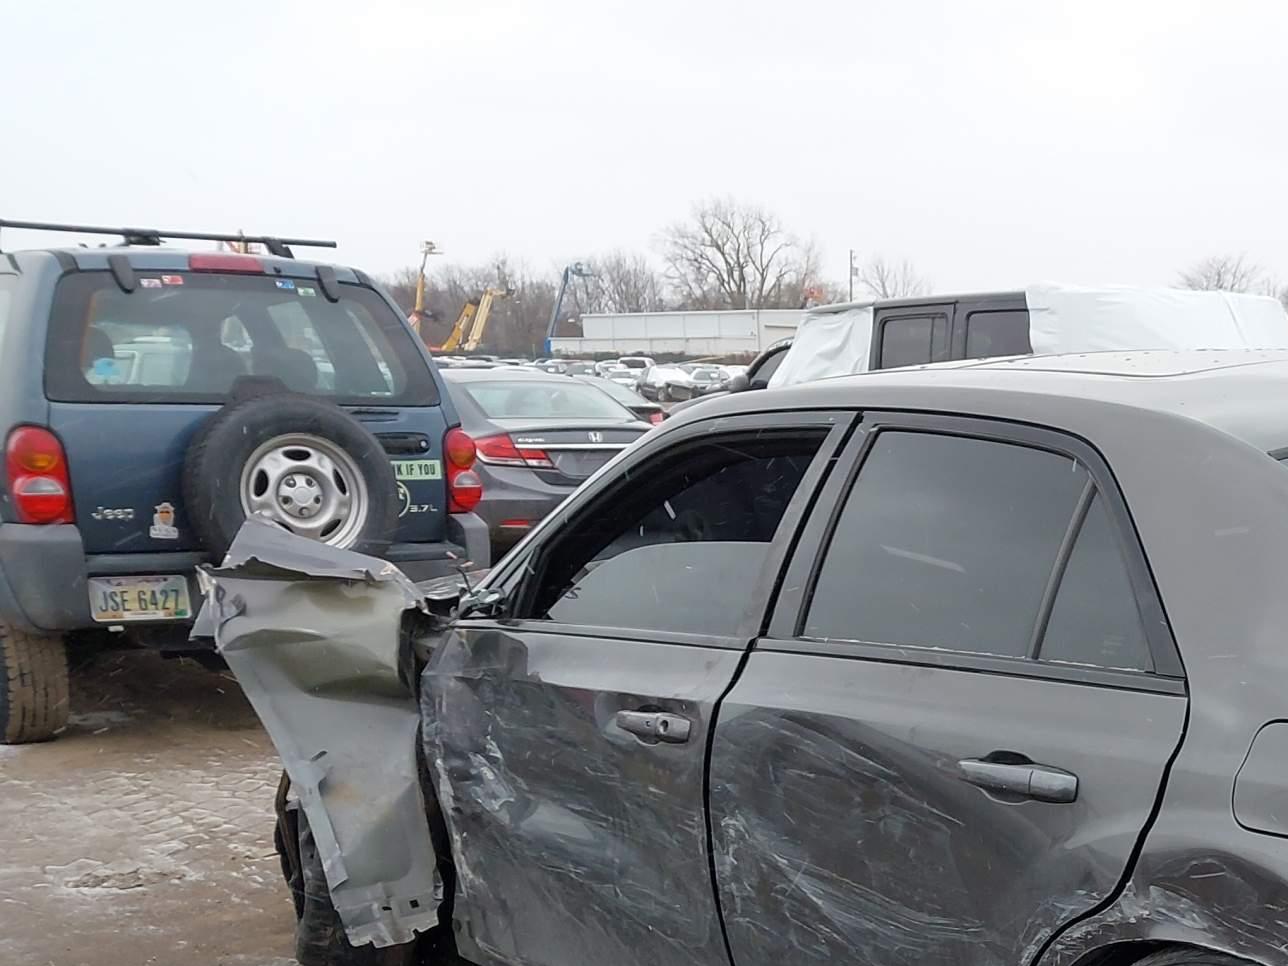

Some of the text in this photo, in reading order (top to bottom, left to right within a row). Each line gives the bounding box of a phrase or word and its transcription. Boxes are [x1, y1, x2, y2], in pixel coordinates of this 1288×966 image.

[406, 463, 414, 476] IF
[417, 463, 436, 476] YOU
[91, 506, 134, 522] Jeep
[409, 504, 438, 513] 3.7L
[99, 589, 180, 612] JSE 6427
